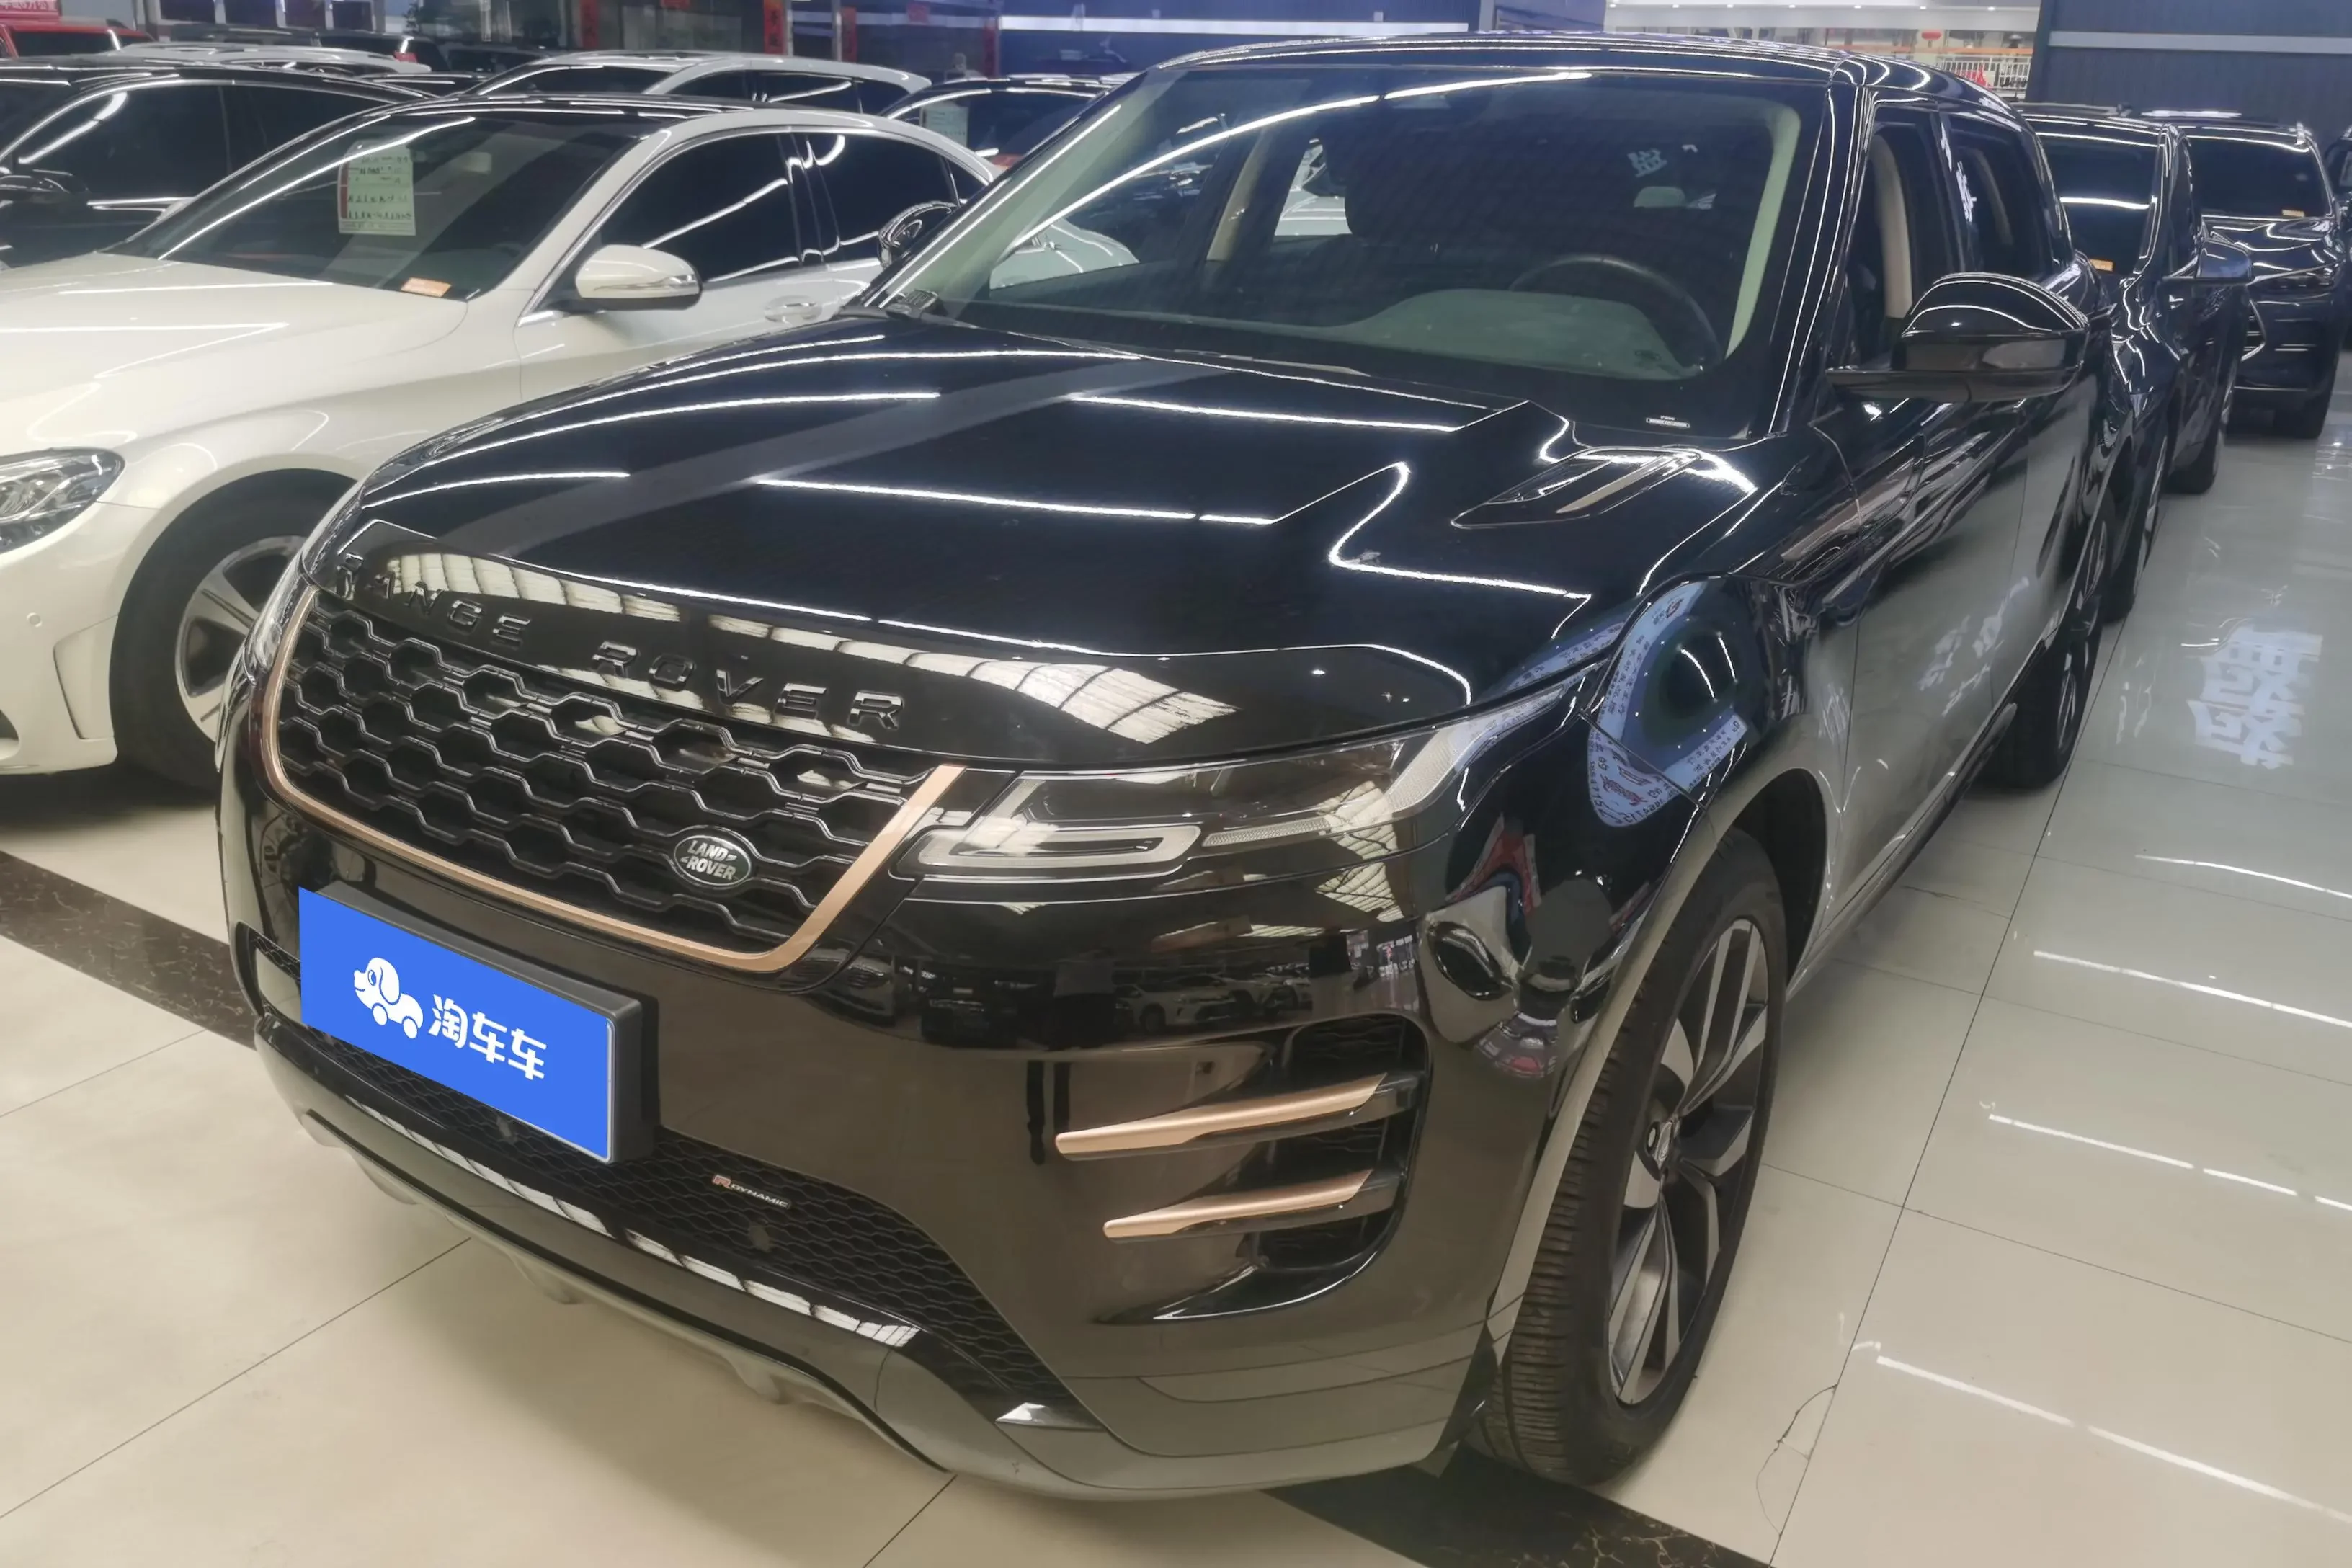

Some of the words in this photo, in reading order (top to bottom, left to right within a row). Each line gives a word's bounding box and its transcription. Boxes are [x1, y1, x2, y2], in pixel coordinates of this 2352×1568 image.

[592, 641, 904, 730] ROVER
[687, 840, 729, 862] LAND
[686, 858, 736, 880] ROVER
